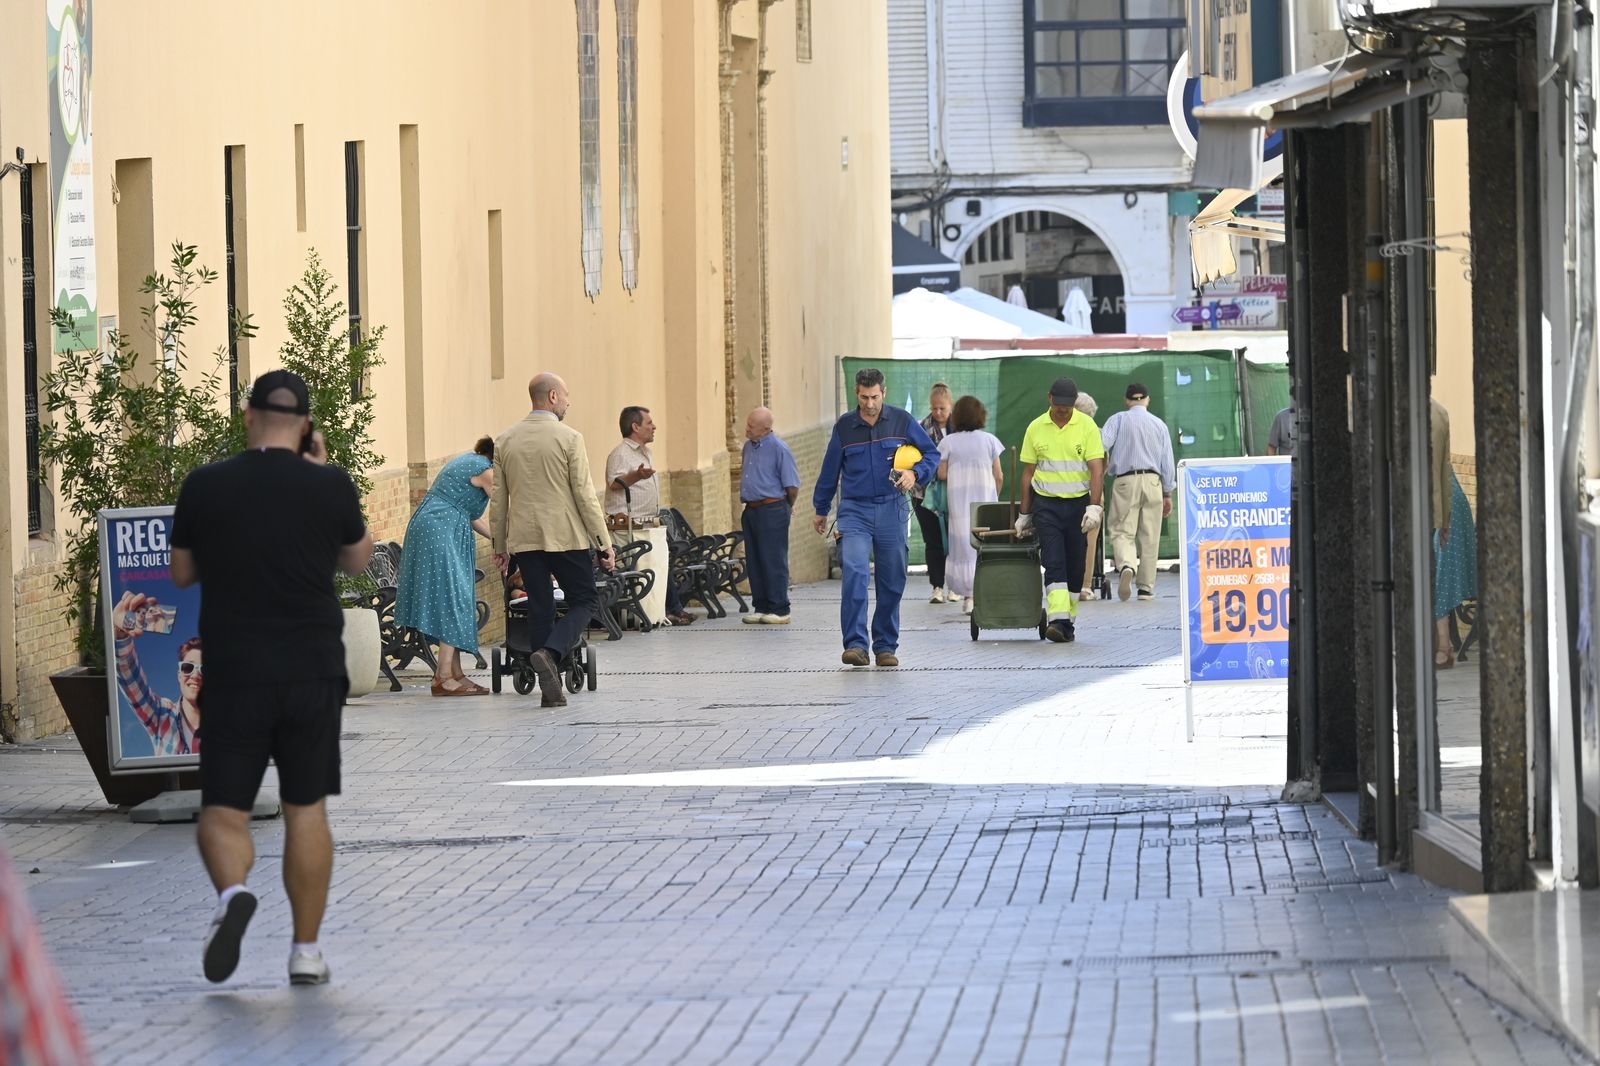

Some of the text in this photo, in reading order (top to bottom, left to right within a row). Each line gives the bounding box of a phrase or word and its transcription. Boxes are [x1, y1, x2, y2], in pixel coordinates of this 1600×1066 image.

[1196, 476, 1238, 489] ¿SE VE YA?
[1208, 493, 1218, 504] TE
[1219, 493, 1229, 504] LO
[1230, 492, 1268, 503] PONEMOS
[1197, 506, 1291, 529] MÁS GRANDE?
[116, 519, 171, 554] REG
[142, 553, 162, 568] QUE
[1206, 547, 1253, 569] FIBRA
[1256, 547, 1268, 568] &
